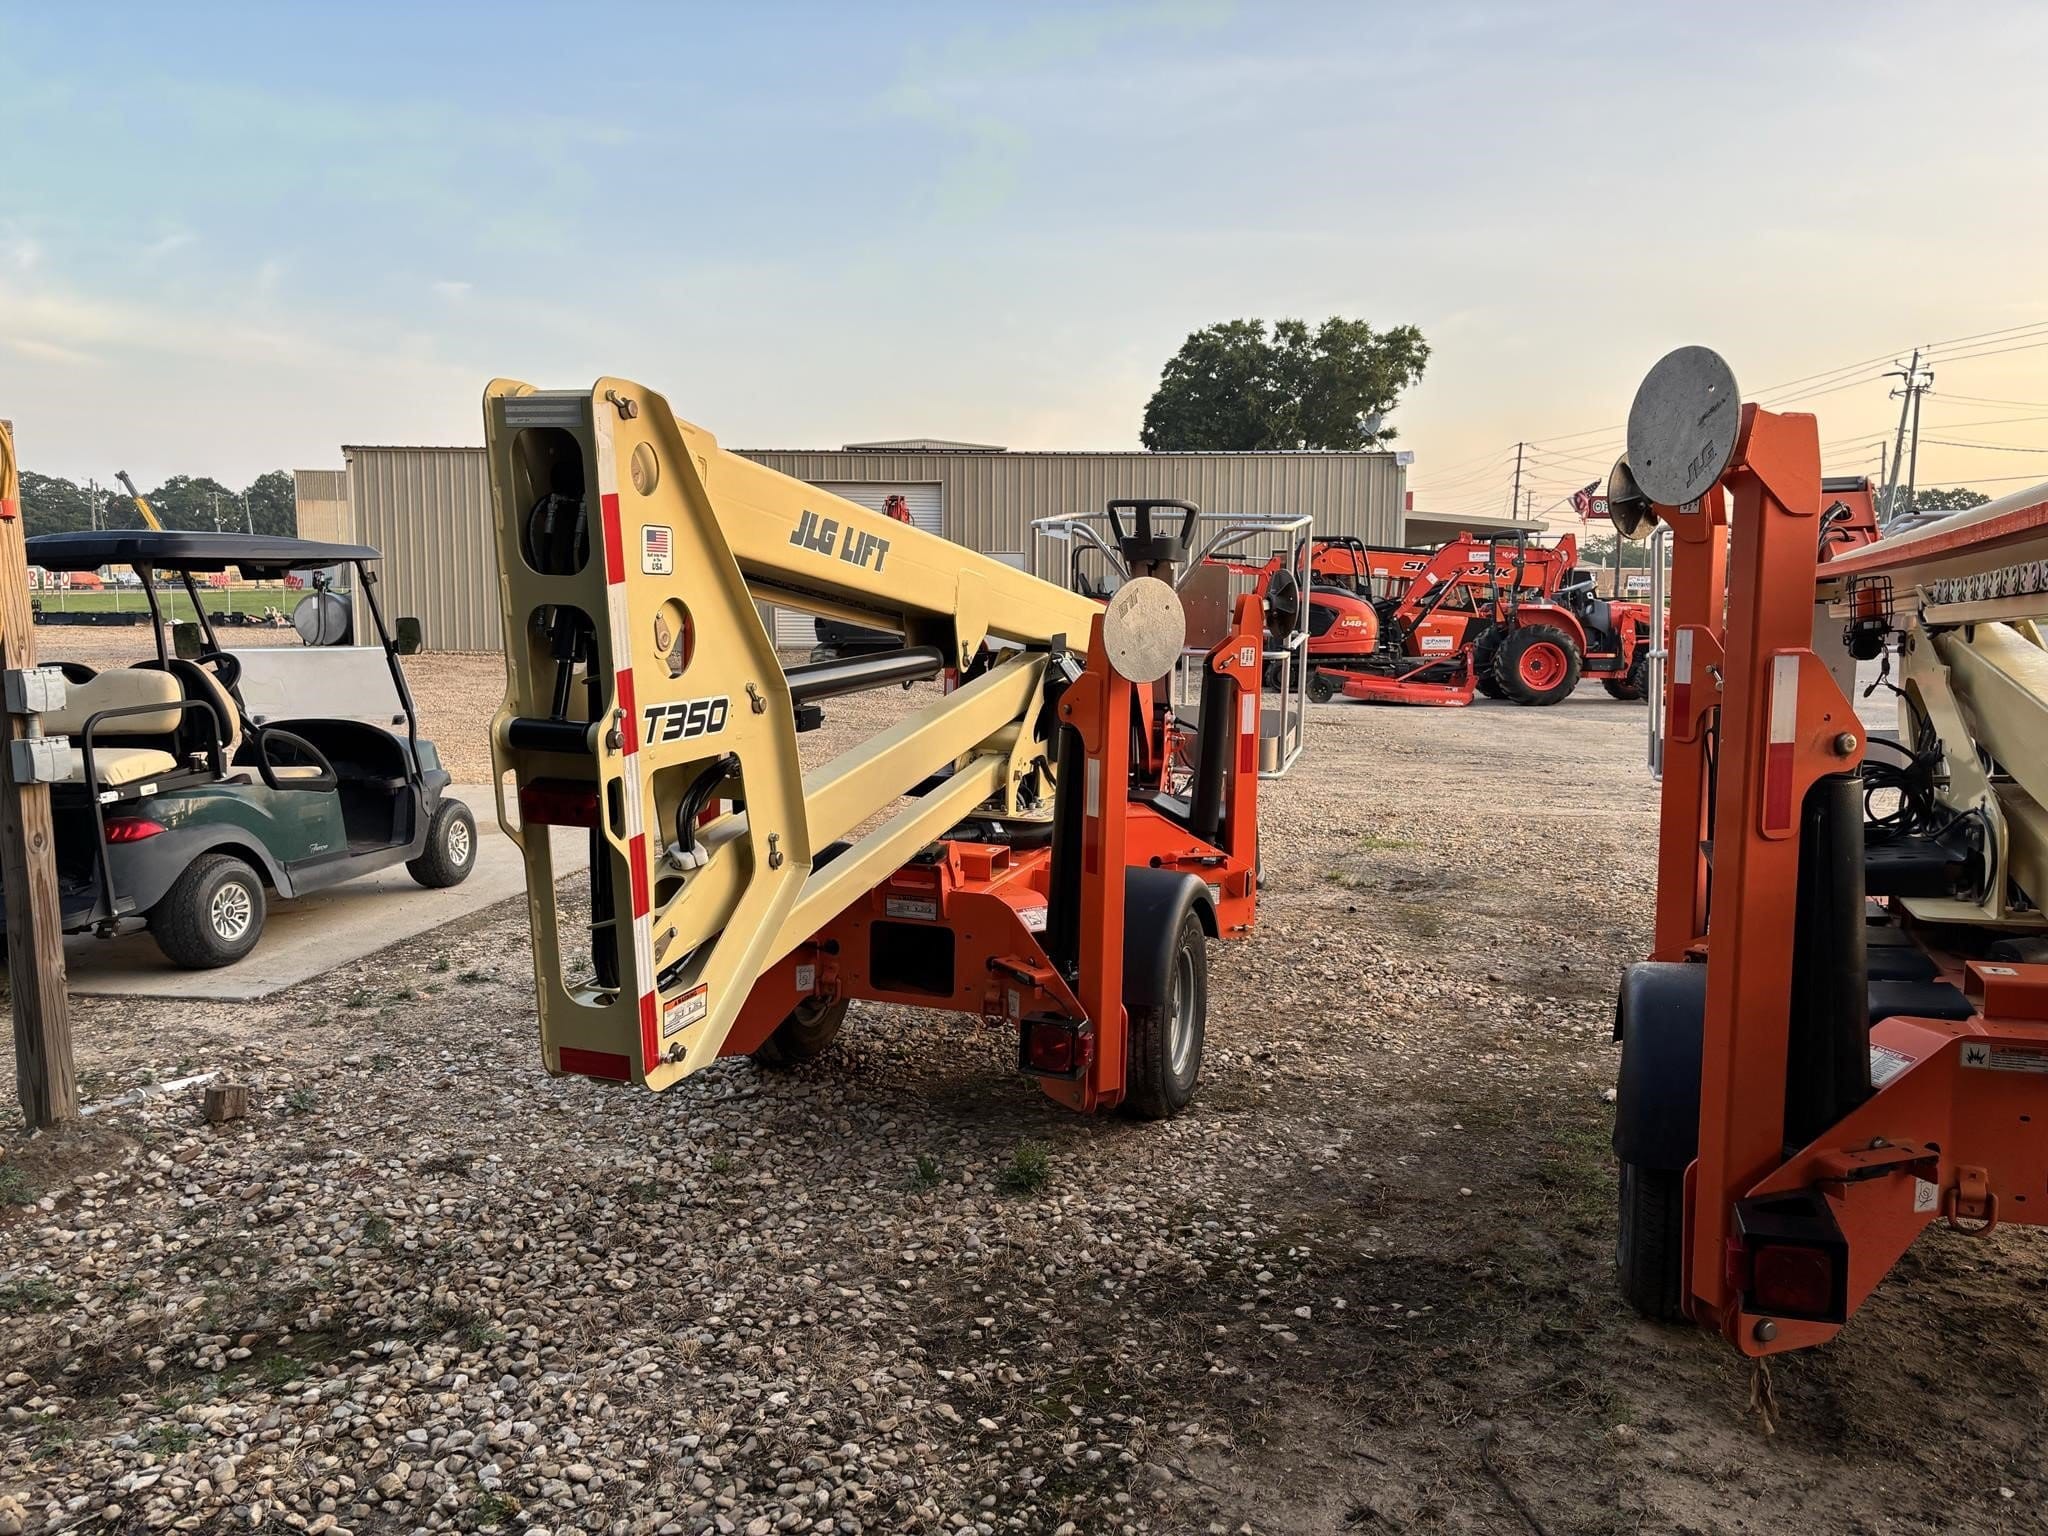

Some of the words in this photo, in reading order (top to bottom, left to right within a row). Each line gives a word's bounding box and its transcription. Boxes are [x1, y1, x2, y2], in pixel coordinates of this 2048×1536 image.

[789, 509, 840, 557] JLG
[839, 526, 891, 573] LIFT
[644, 698, 729, 745] T350
